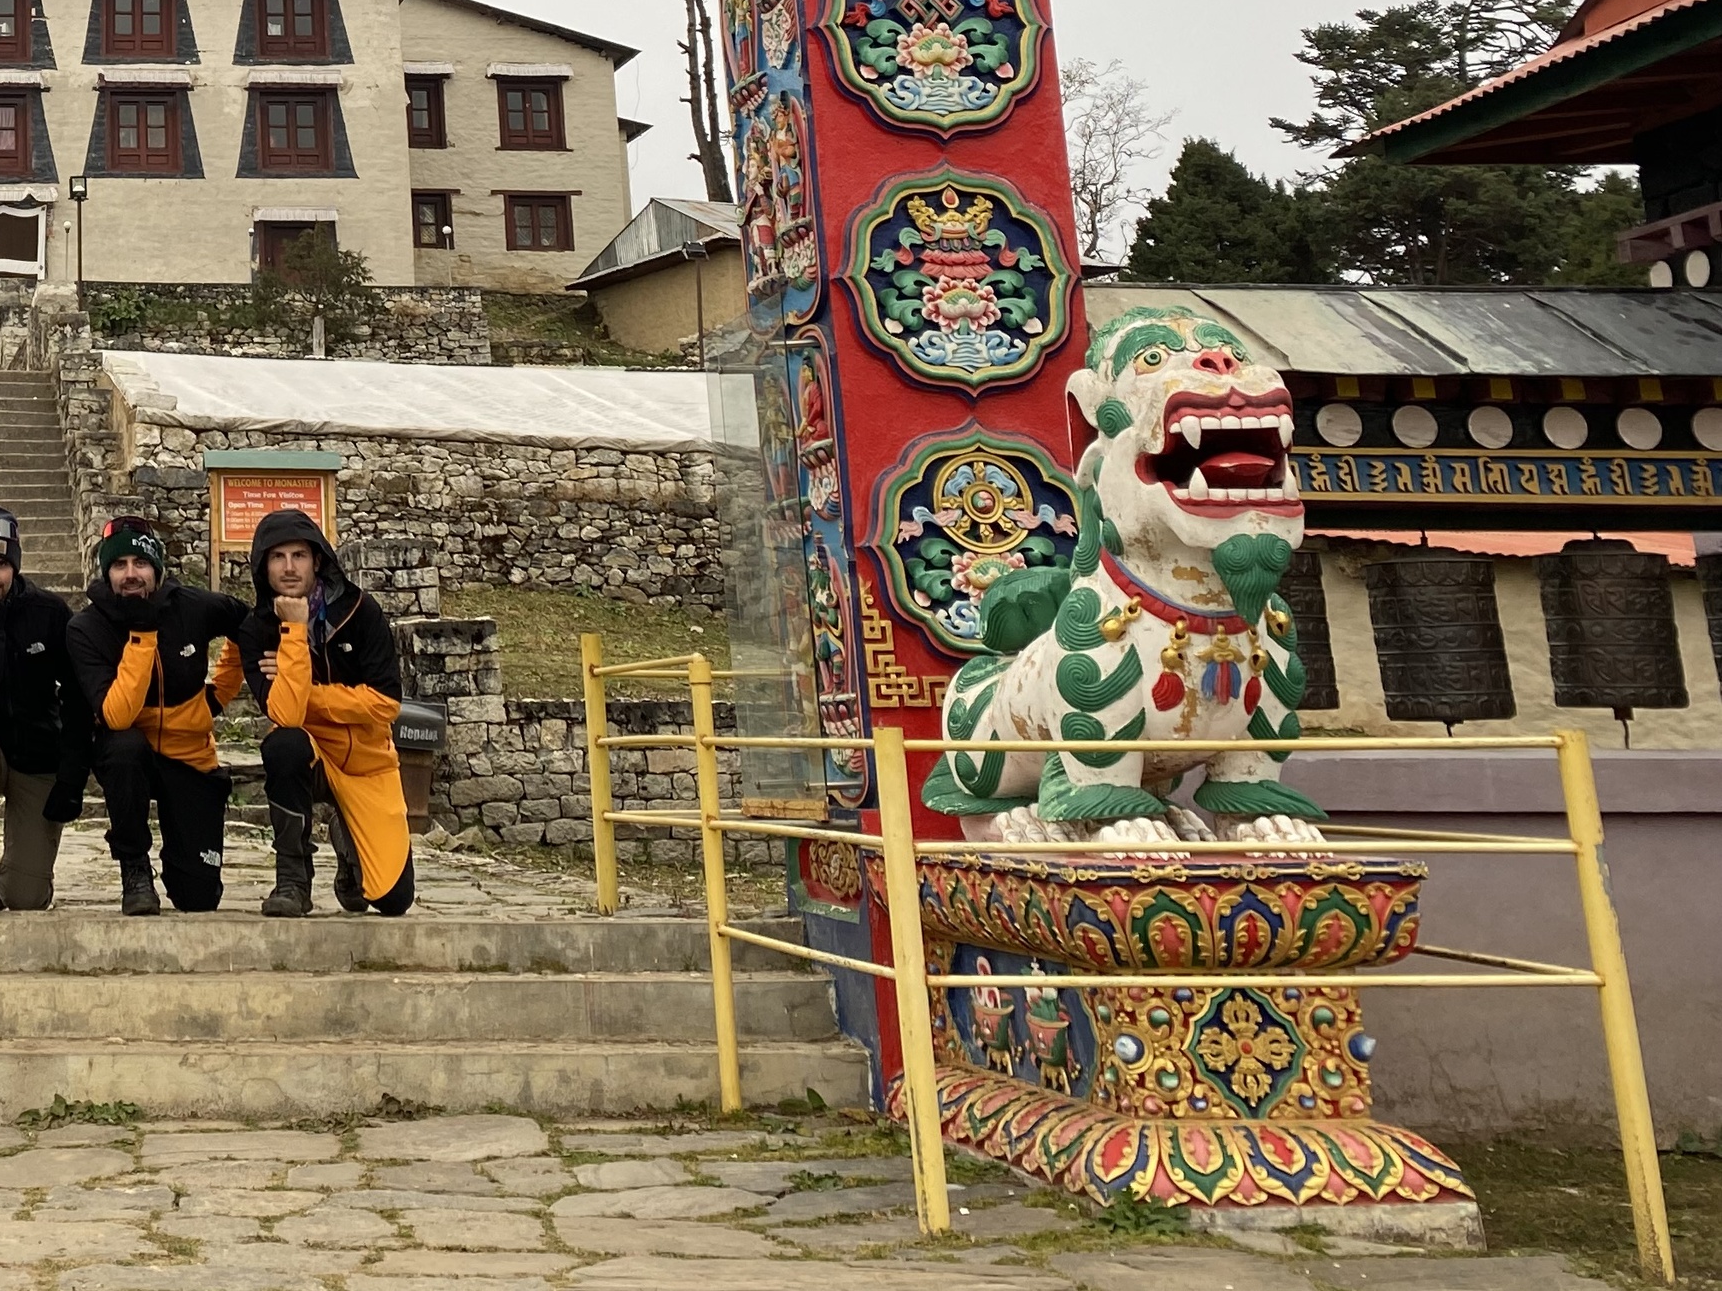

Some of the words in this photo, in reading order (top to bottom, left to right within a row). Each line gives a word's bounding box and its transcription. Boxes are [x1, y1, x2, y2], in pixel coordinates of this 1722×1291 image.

[227, 479, 262, 488] WELCOME
[263, 479, 273, 488] TO
[274, 479, 317, 488] MONASTERY
[263, 491, 276, 499] For
[228, 501, 246, 509] Open
[247, 501, 264, 509] Time
